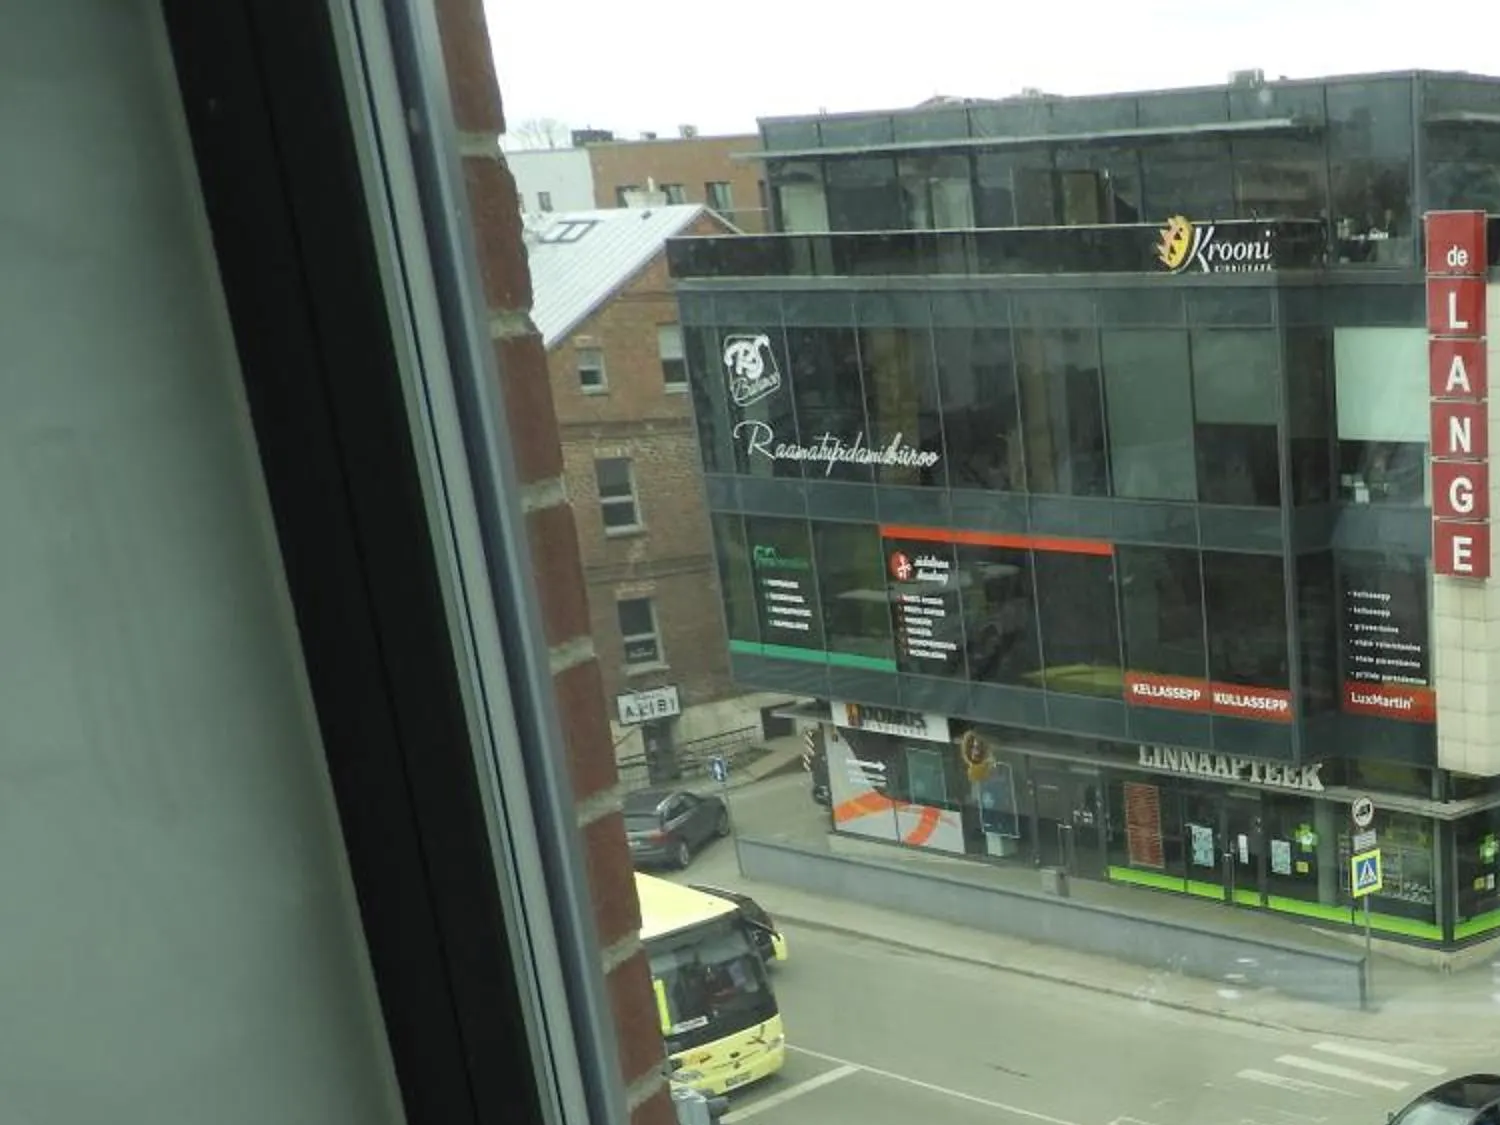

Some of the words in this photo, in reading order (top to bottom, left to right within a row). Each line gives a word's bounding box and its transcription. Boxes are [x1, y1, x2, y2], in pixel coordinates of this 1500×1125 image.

[1180, 226, 1272, 273] Krooni
[1447, 245, 1469, 267] de
[1446, 292, 1474, 572] LANGE
[1132, 683, 1201, 701] KELLASSEPP
[1213, 692, 1287, 711] KULLASSEPP
[1351, 692, 1411, 709] LuxMartin
[1138, 744, 1325, 791] LINNAAPTEEK
